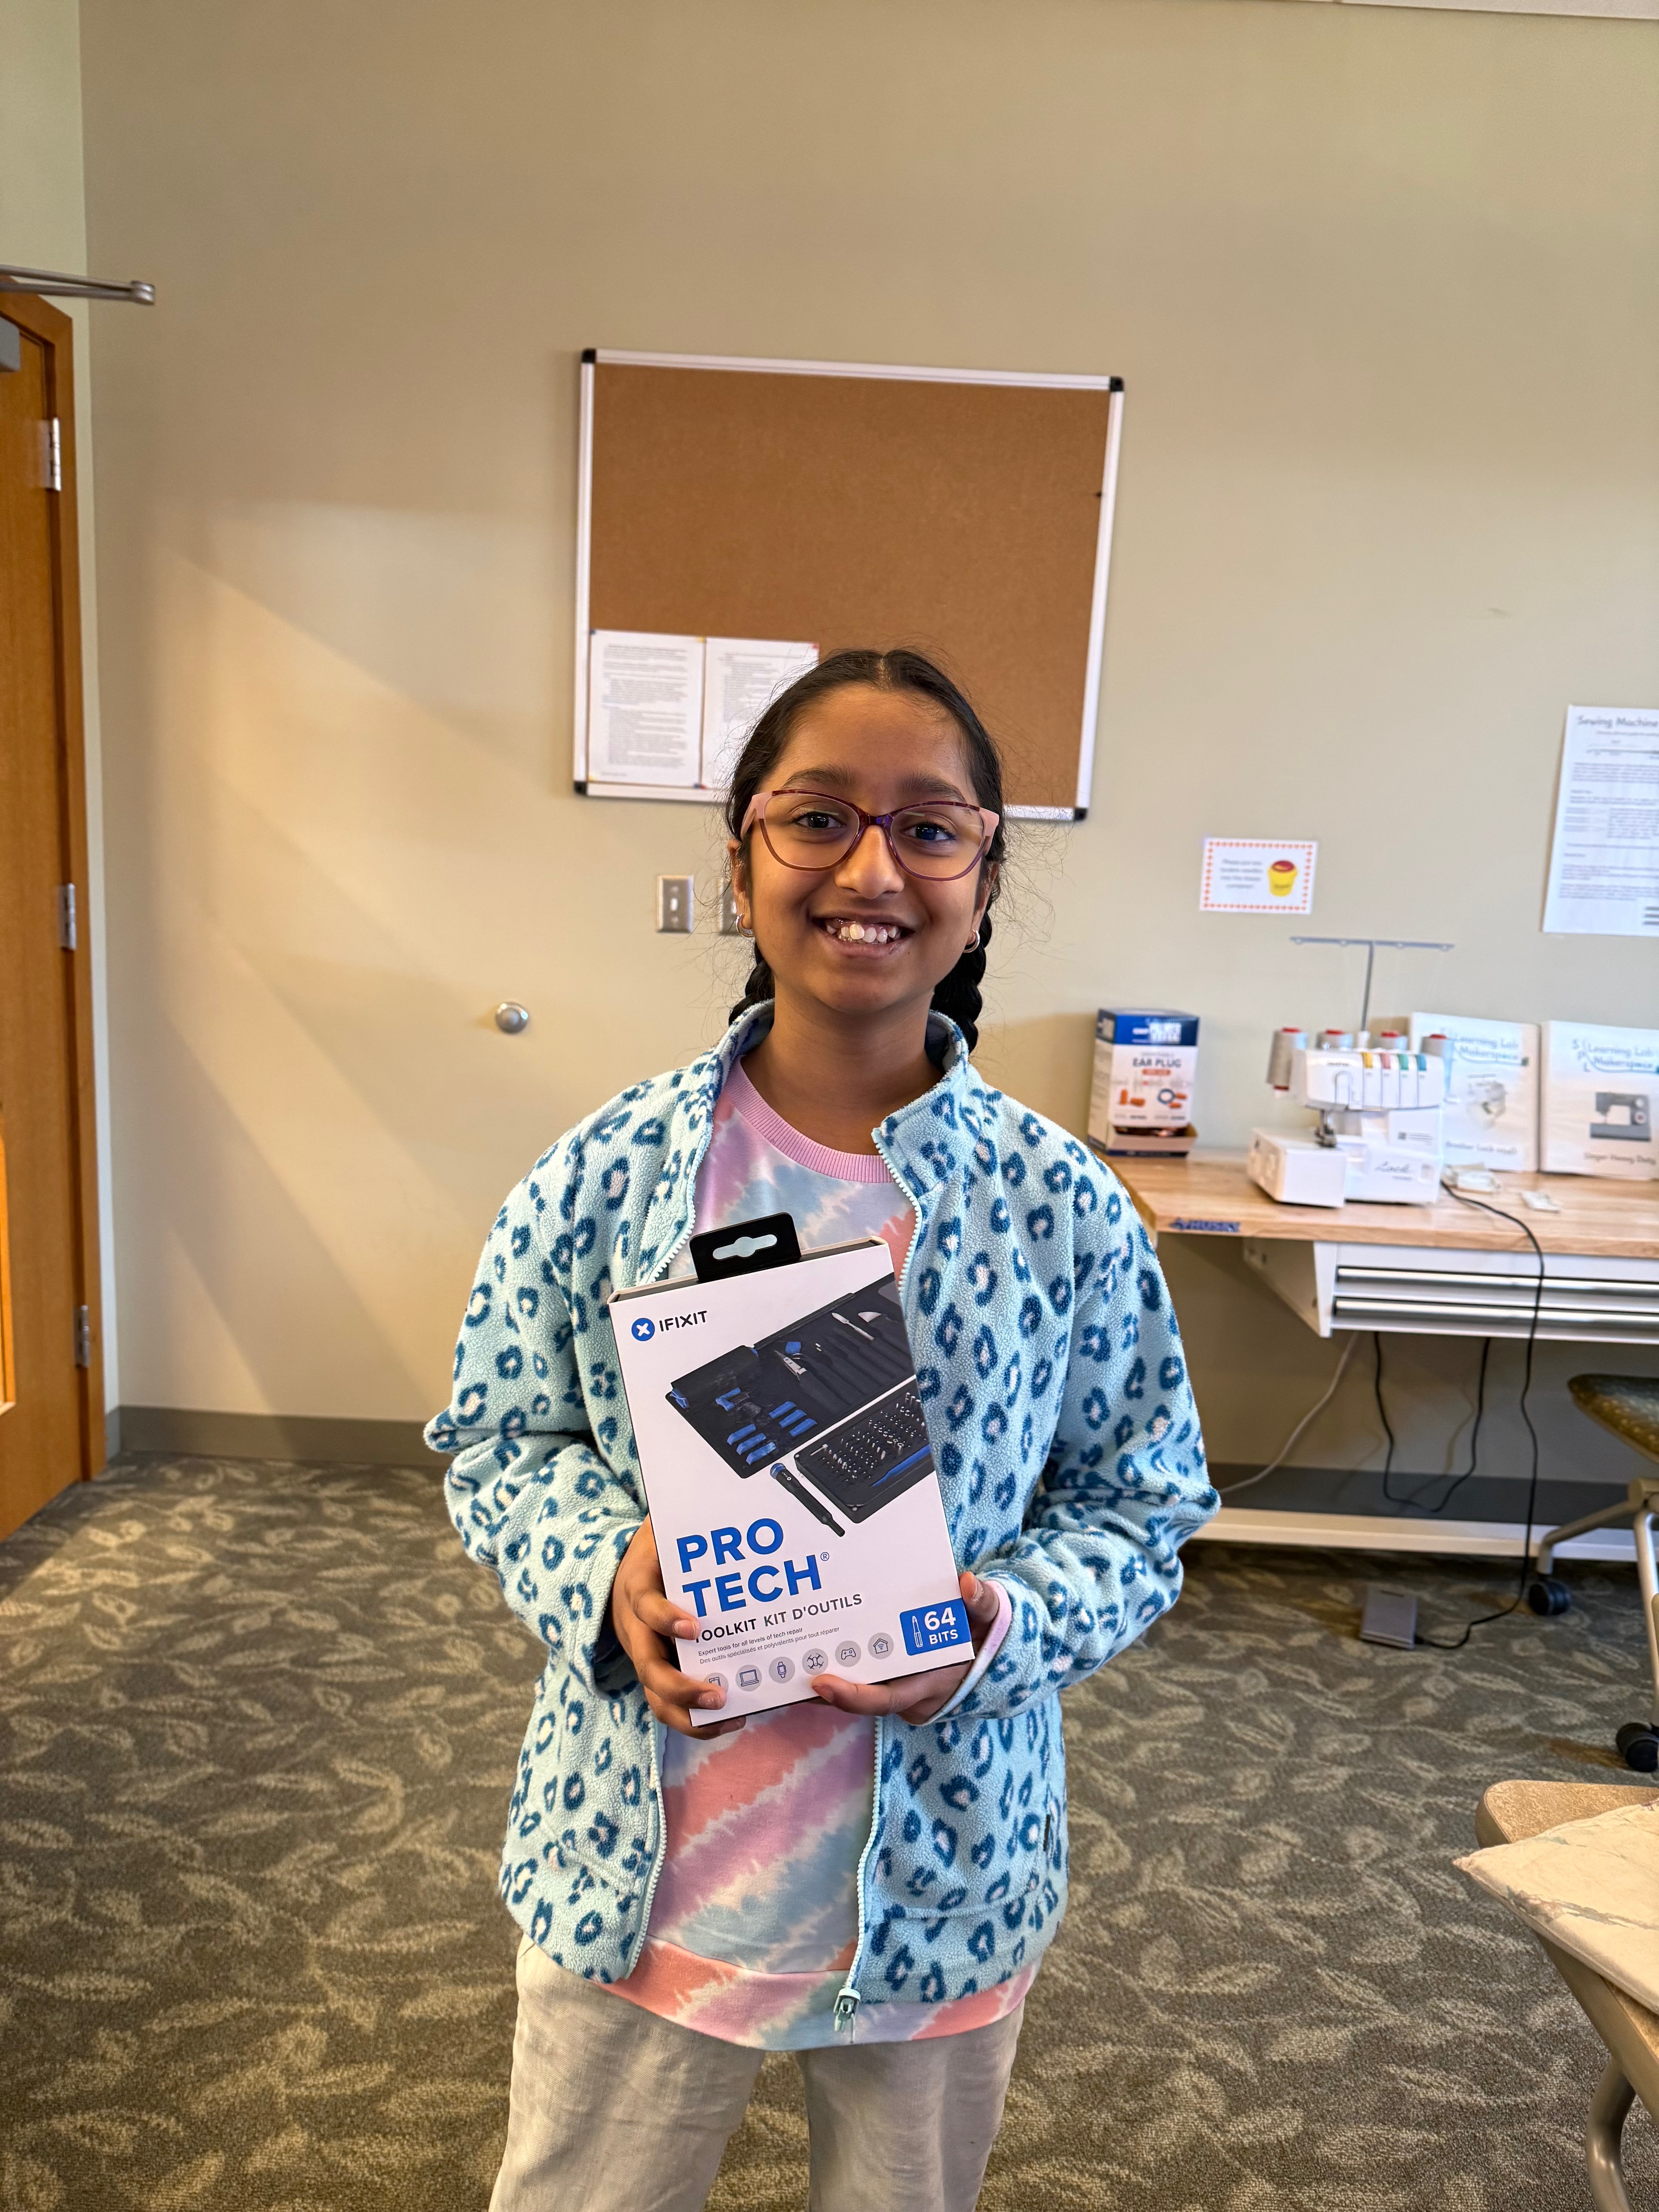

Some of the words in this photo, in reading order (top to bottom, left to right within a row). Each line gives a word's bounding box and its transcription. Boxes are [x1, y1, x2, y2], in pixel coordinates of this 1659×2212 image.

[1578, 715, 1613, 728] Sewing
[1616, 717, 1658, 727] Machine
[1133, 1058, 1152, 1067] EAR
[1155, 1058, 1181, 1068] PLUG
[659, 1310, 707, 1332] IFIXIT
[676, 1518, 783, 1573] PRO
[696, 1618, 756, 1643] OOLKIT
[764, 1611, 787, 1627] KIT
[792, 1594, 862, 1620] D'OUTILS
[924, 1607, 956, 1630] 64
[929, 1629, 958, 1645] BITS
[698, 1648, 716, 1656] Expert
